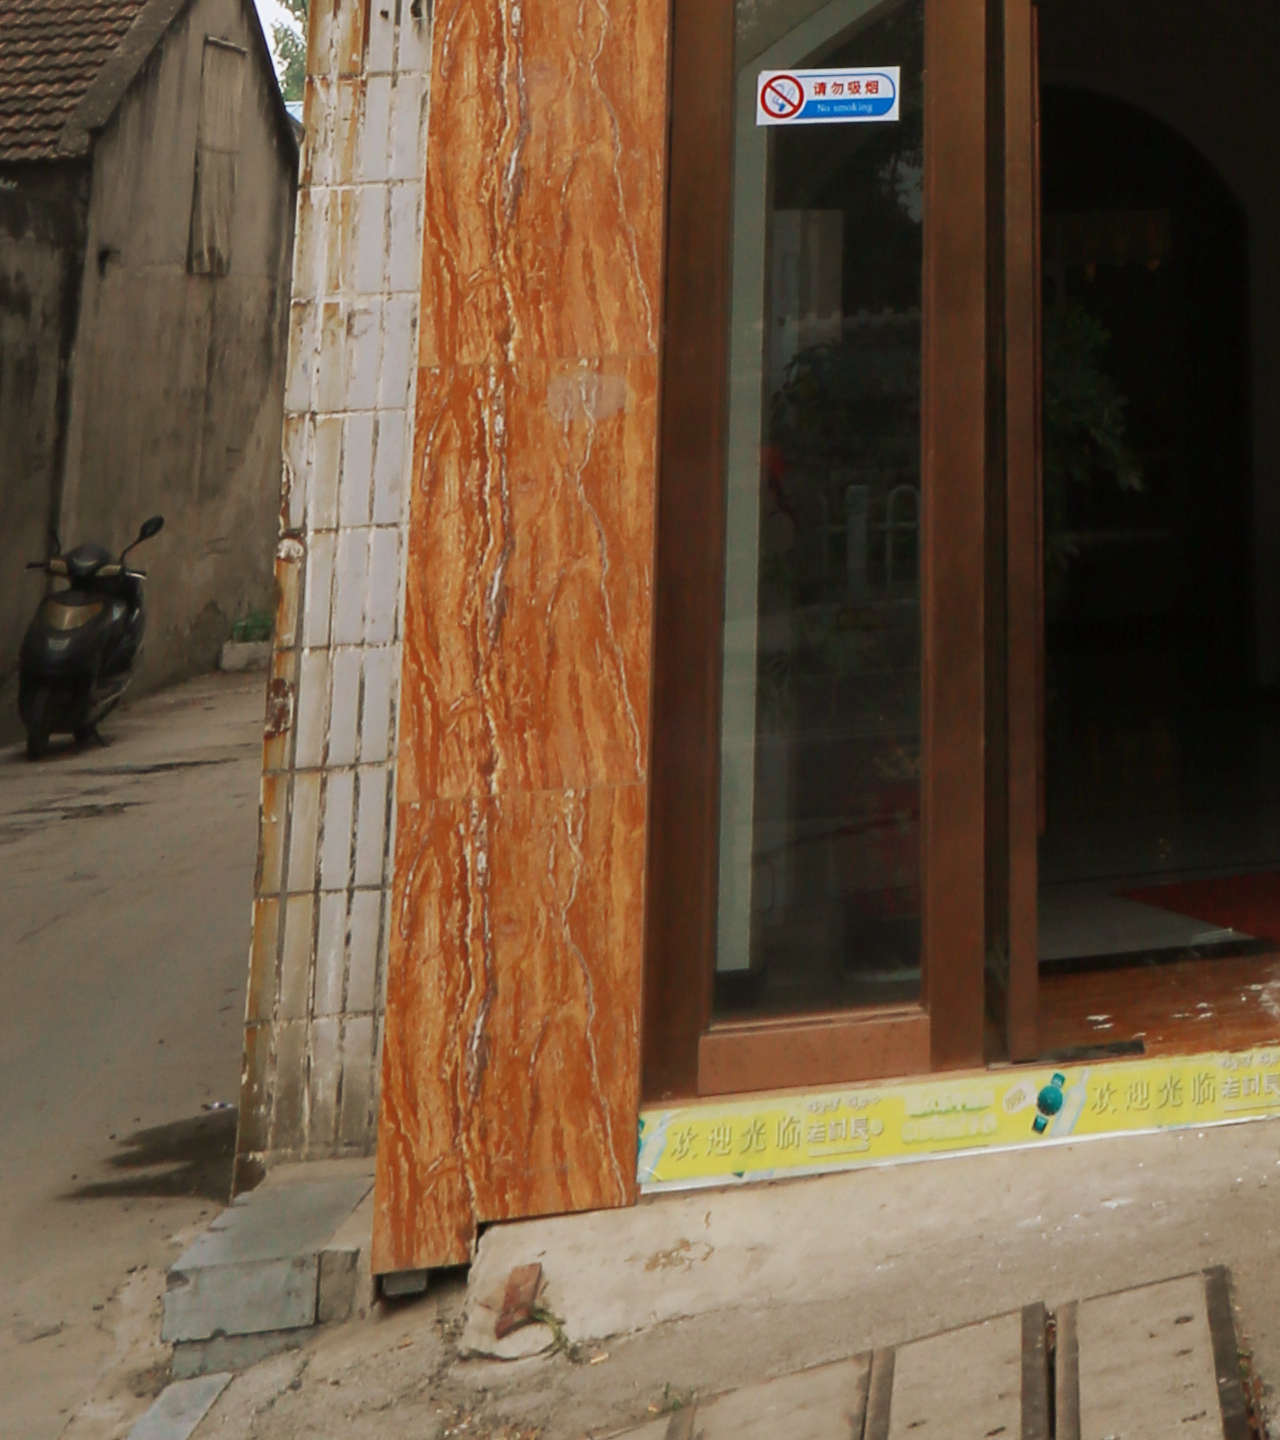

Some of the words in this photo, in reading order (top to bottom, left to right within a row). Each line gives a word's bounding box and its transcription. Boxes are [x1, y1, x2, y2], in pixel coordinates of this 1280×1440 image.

[813, 81, 880, 97] 请勿吸烟
[817, 104, 831, 113] No
[833, 103, 873, 115] smoking
[1091, 1074, 1217, 1116] 欢迎光临
[670, 1116, 801, 1161] 欢迎光临
